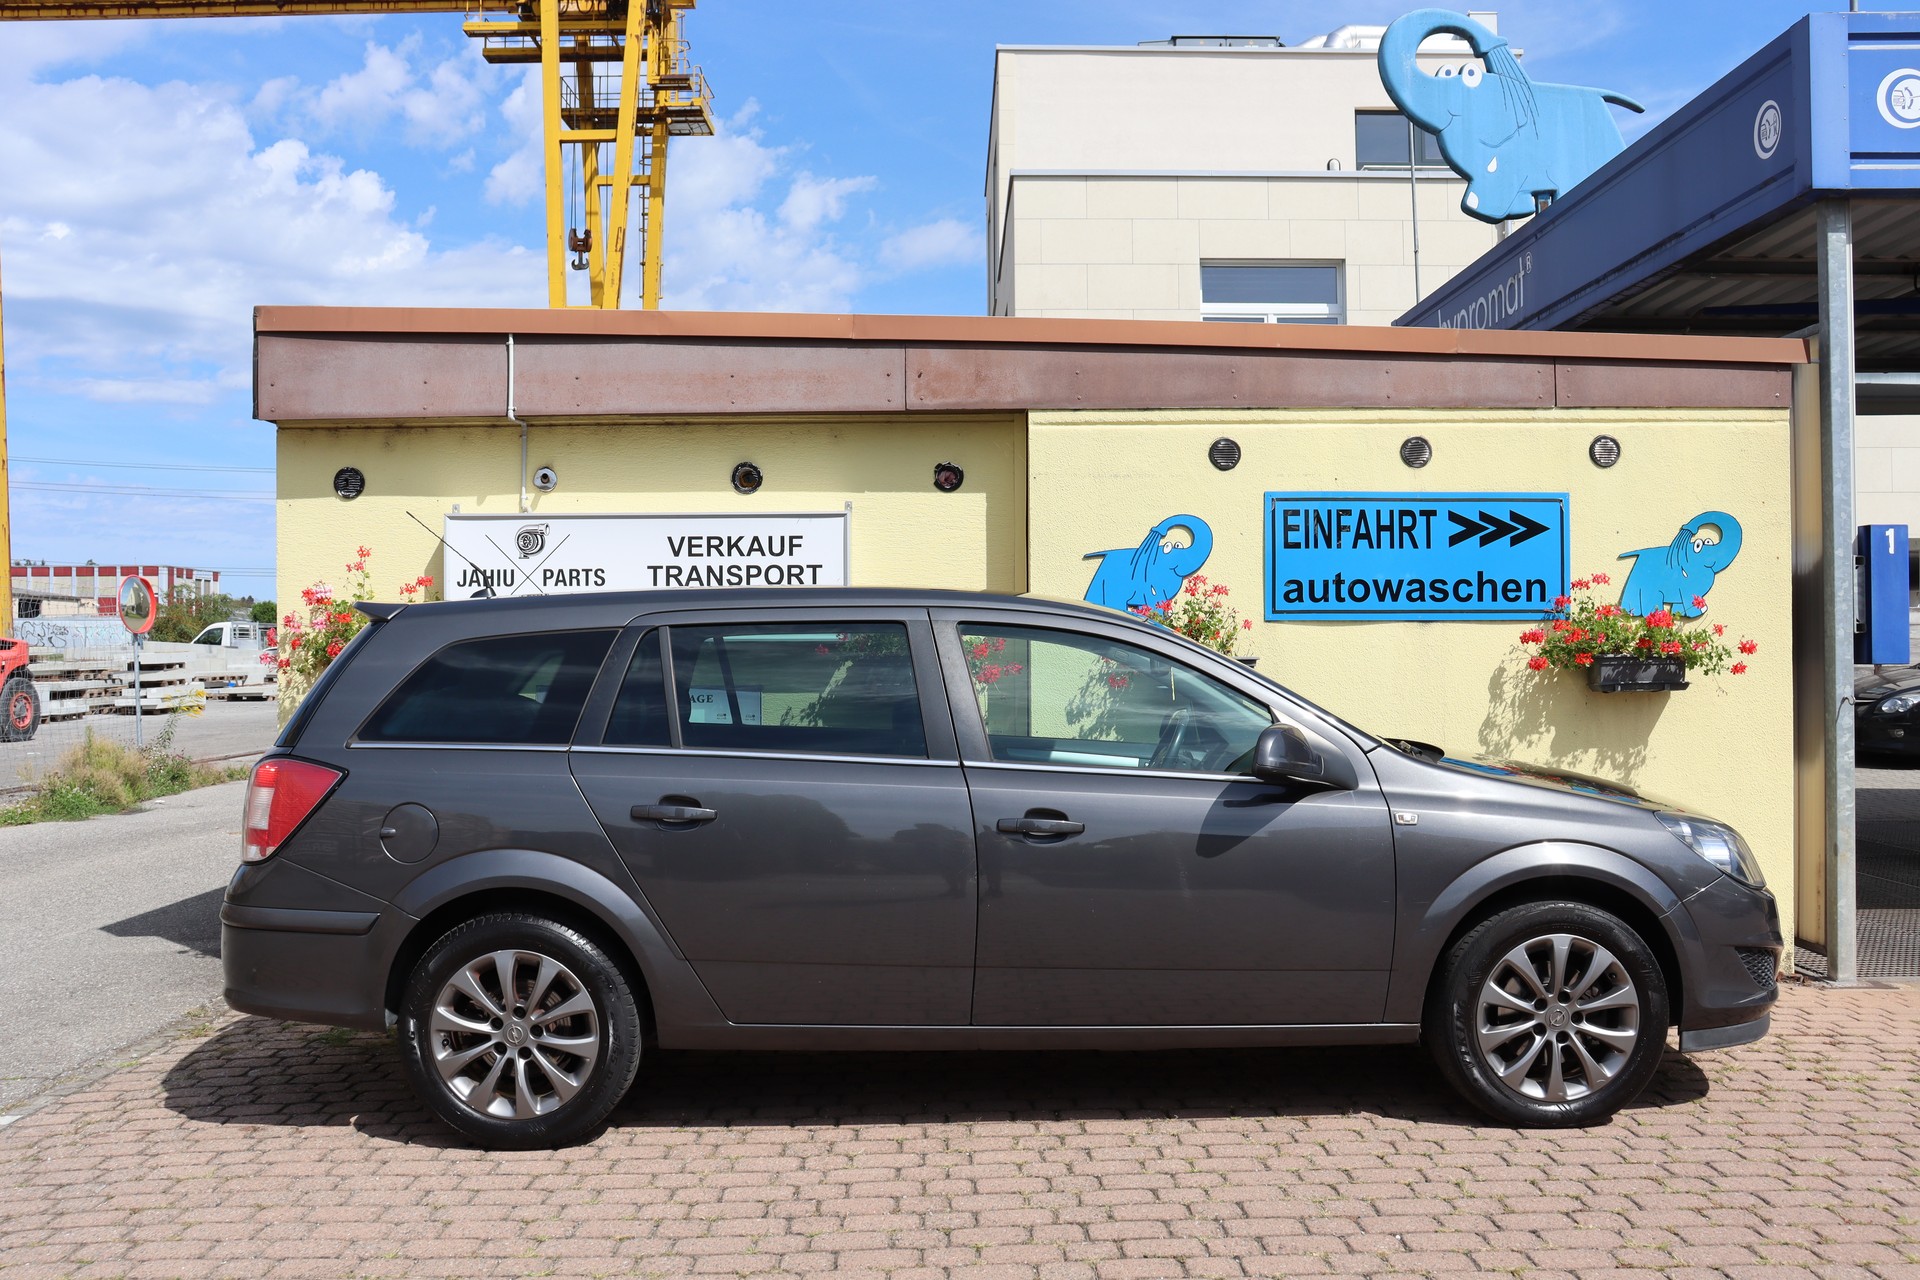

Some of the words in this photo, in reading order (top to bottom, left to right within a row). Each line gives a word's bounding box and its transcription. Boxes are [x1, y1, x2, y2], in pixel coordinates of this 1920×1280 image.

[1283, 509, 1437, 549] EINFAHRT
[1885, 528, 1895, 555] 1
[667, 535, 804, 557] VERKAUF
[543, 568, 606, 587] PARTS
[647, 564, 823, 587] TRANSPORT
[1283, 571, 1547, 603] autowaschen
